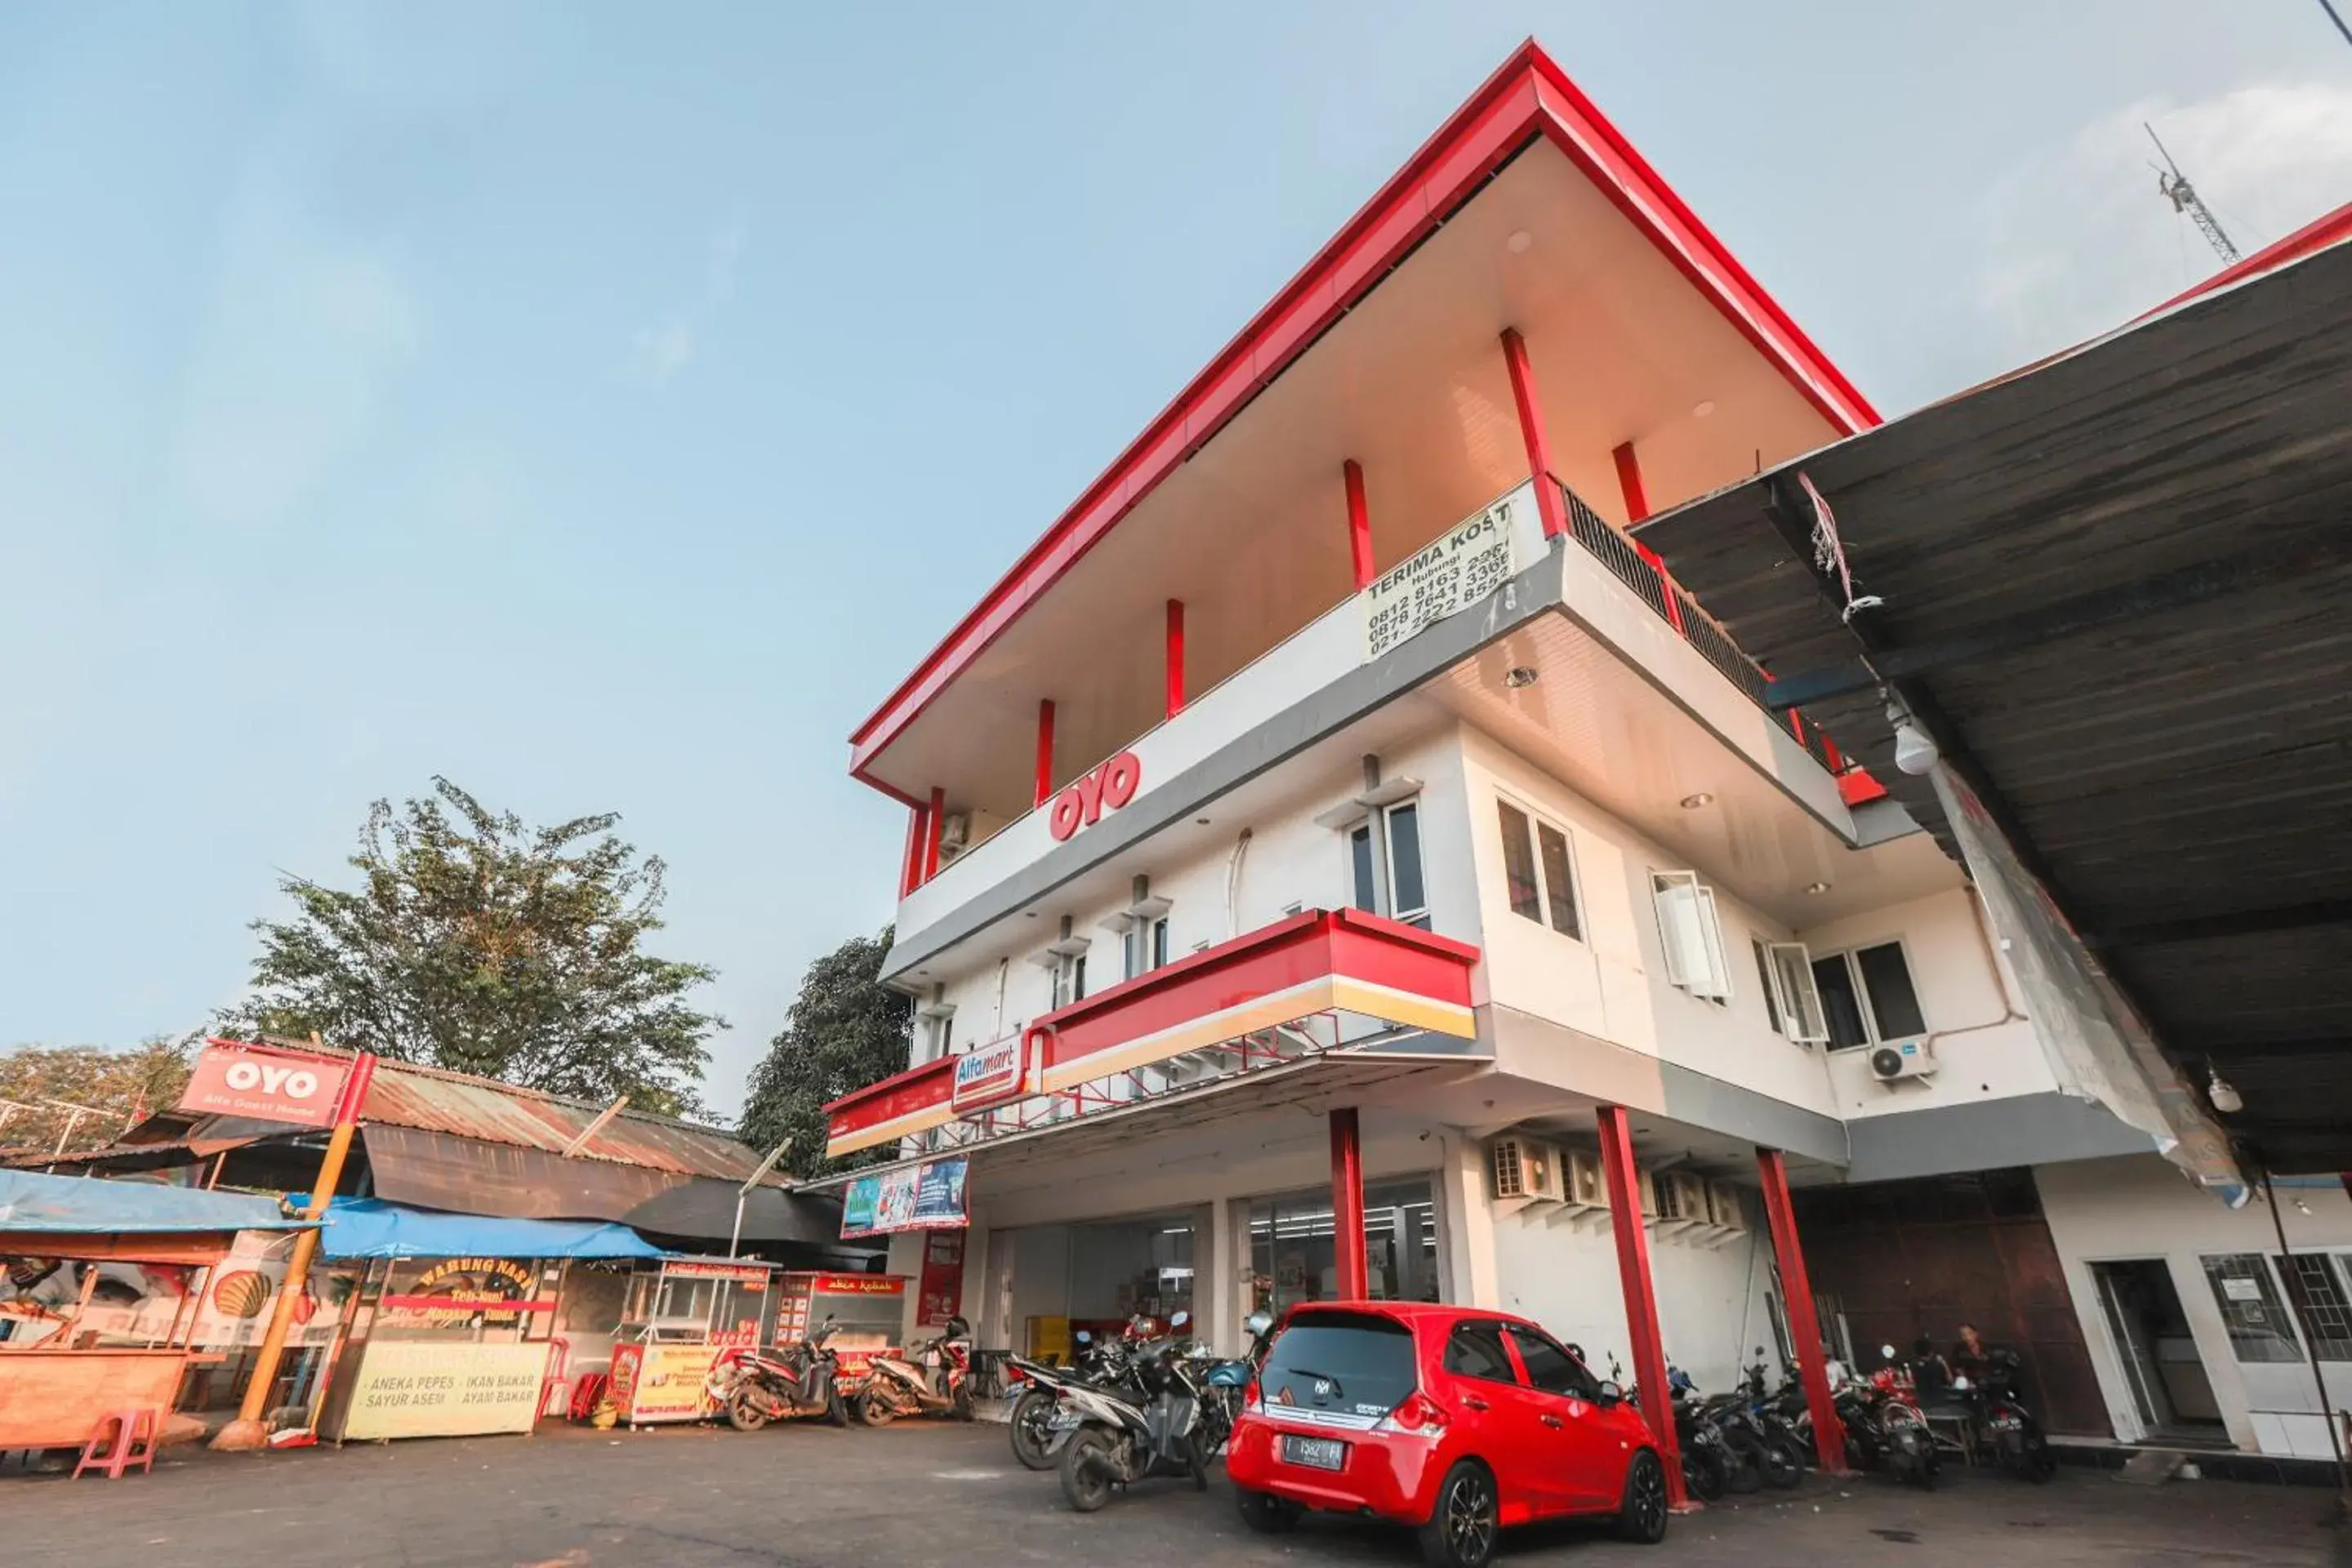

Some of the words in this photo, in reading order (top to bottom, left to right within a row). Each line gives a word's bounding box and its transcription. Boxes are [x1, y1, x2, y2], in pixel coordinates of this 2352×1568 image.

[1369, 546, 1443, 599] TERIMA
[1451, 502, 1509, 551] KOST
[1411, 552, 1460, 585] Hubungi
[1369, 596, 1409, 629] 0812
[1414, 567, 1459, 600] 8163
[1369, 611, 1409, 643] 0878
[1414, 582, 1458, 614] 7641
[1410, 598, 1457, 630] 2222
[1050, 751, 1140, 841] OYO
[225, 1061, 318, 1099] OYO
[957, 1045, 1013, 1083] Alfamart
[204, 1093, 231, 1105] Alfa
[235, 1098, 274, 1111] Guest
[276, 1103, 315, 1117] House
[419, 1258, 495, 1286] WARUNG
[367, 1394, 408, 1408] SAYUR
[462, 1392, 496, 1405] AYAM
[497, 1391, 534, 1403] BAKAR
[371, 1377, 414, 1390] ANEKA
[417, 1376, 456, 1389] PEPES
[466, 1376, 495, 1388] IKAN
[497, 1375, 534, 1388] BAKAR
